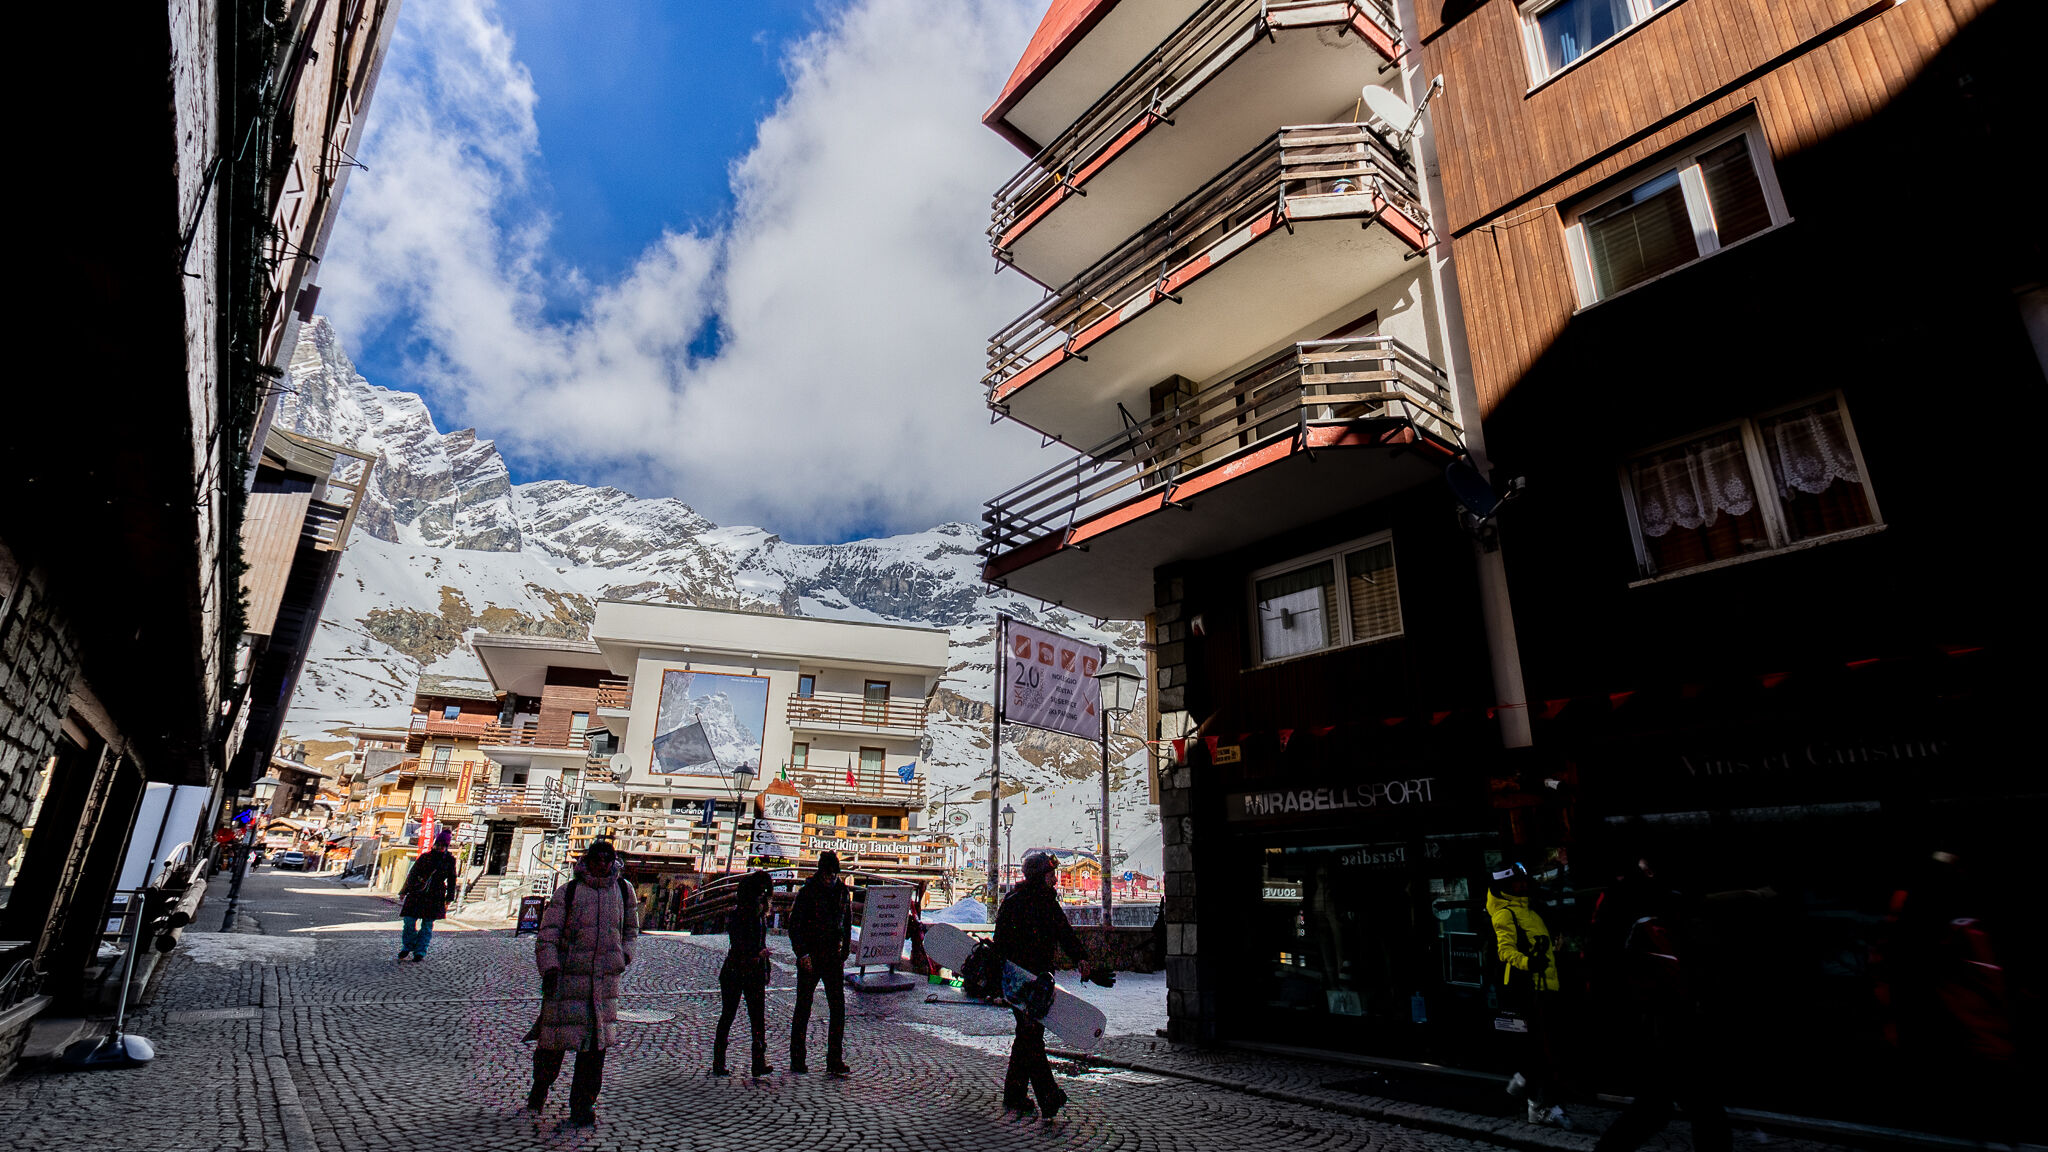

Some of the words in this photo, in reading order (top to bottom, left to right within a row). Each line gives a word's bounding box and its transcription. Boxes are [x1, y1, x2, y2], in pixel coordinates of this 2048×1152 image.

[1015, 661, 1040, 688] 2.0
[1058, 698, 1077, 709] SERCE
[808, 836, 867, 855] Paragliding
[868, 841, 912, 854] Tandem
